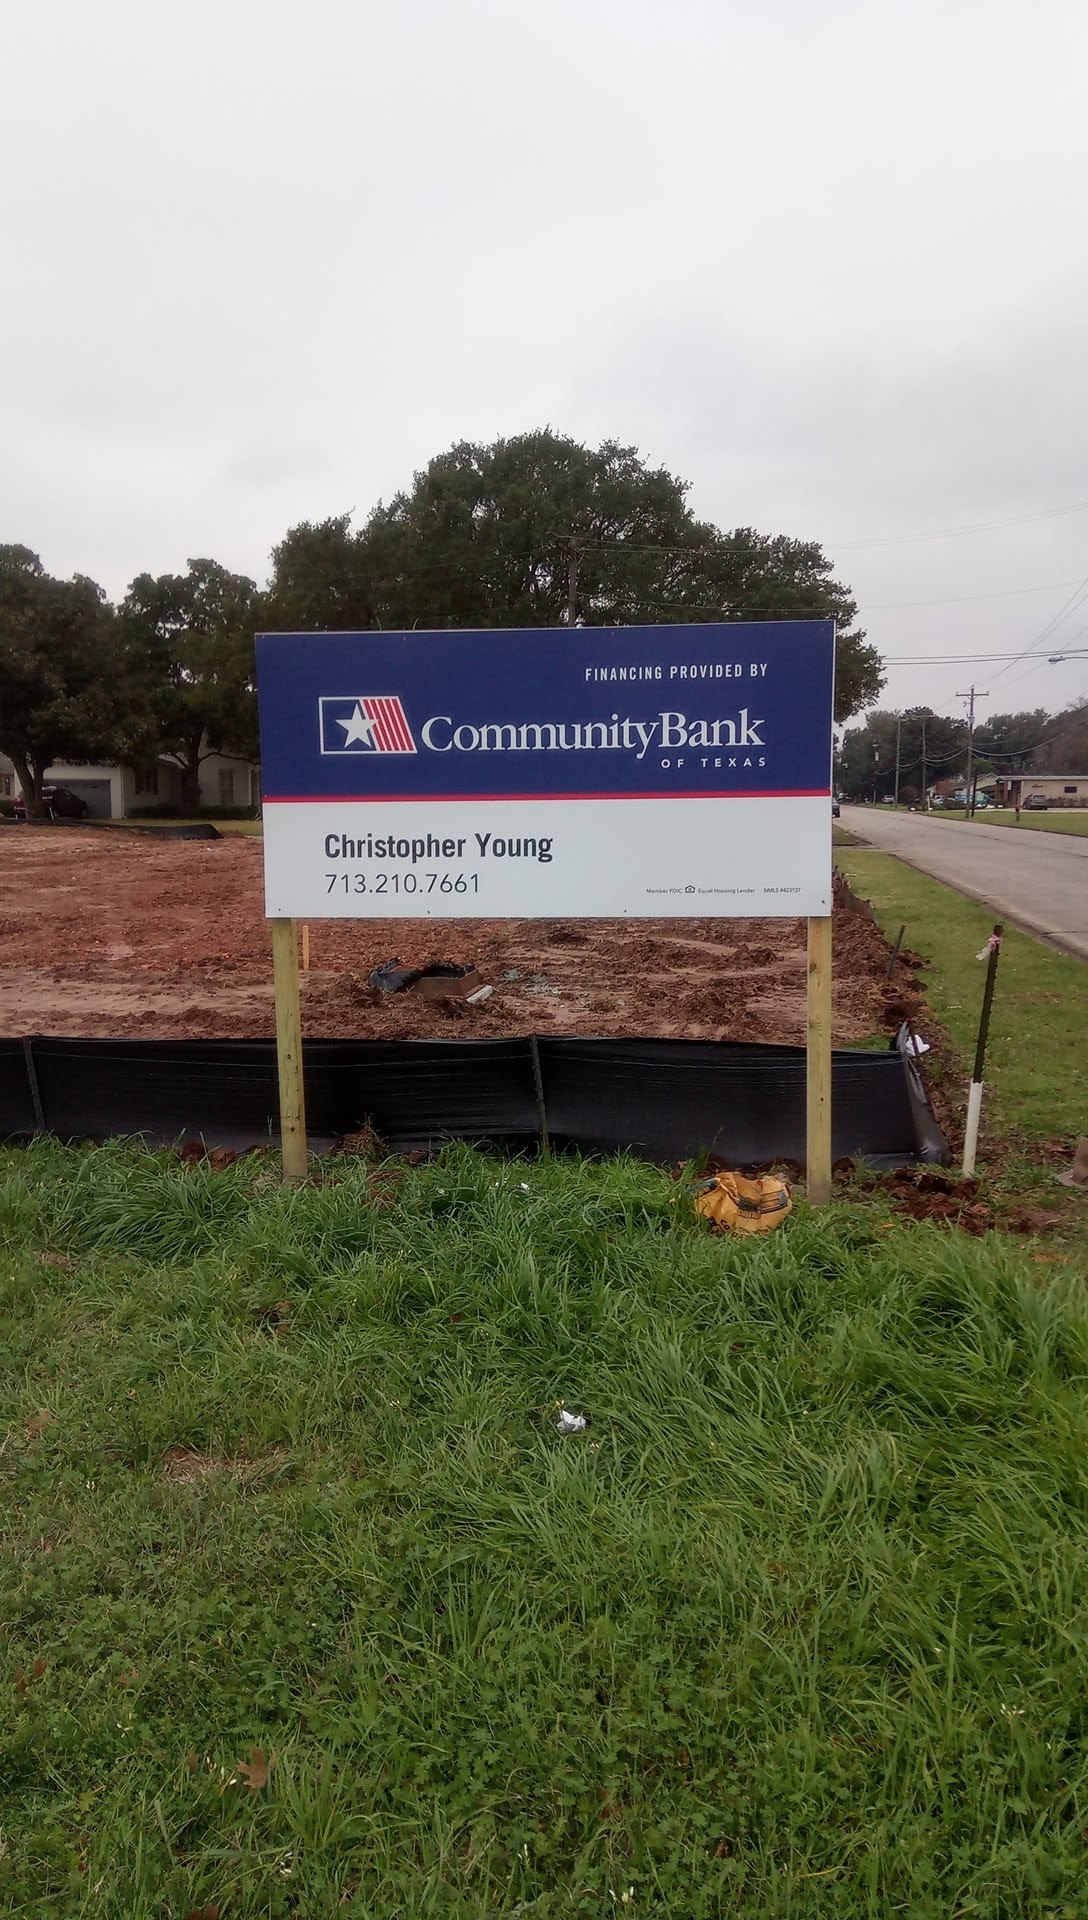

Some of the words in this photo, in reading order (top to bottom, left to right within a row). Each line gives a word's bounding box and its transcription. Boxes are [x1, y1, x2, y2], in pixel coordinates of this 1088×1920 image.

[585, 667, 662, 682] FINANCING
[669, 665, 744, 680] PROVIDED
[750, 663, 768, 678] BY
[421, 707, 766, 760] CommunityBank
[660, 758, 684, 770] OF
[701, 757, 767, 769] TEXAS
[324, 833, 467, 864] Christopher
[474, 832, 554, 863] Young
[324, 873, 479, 895] 713.210.7661
